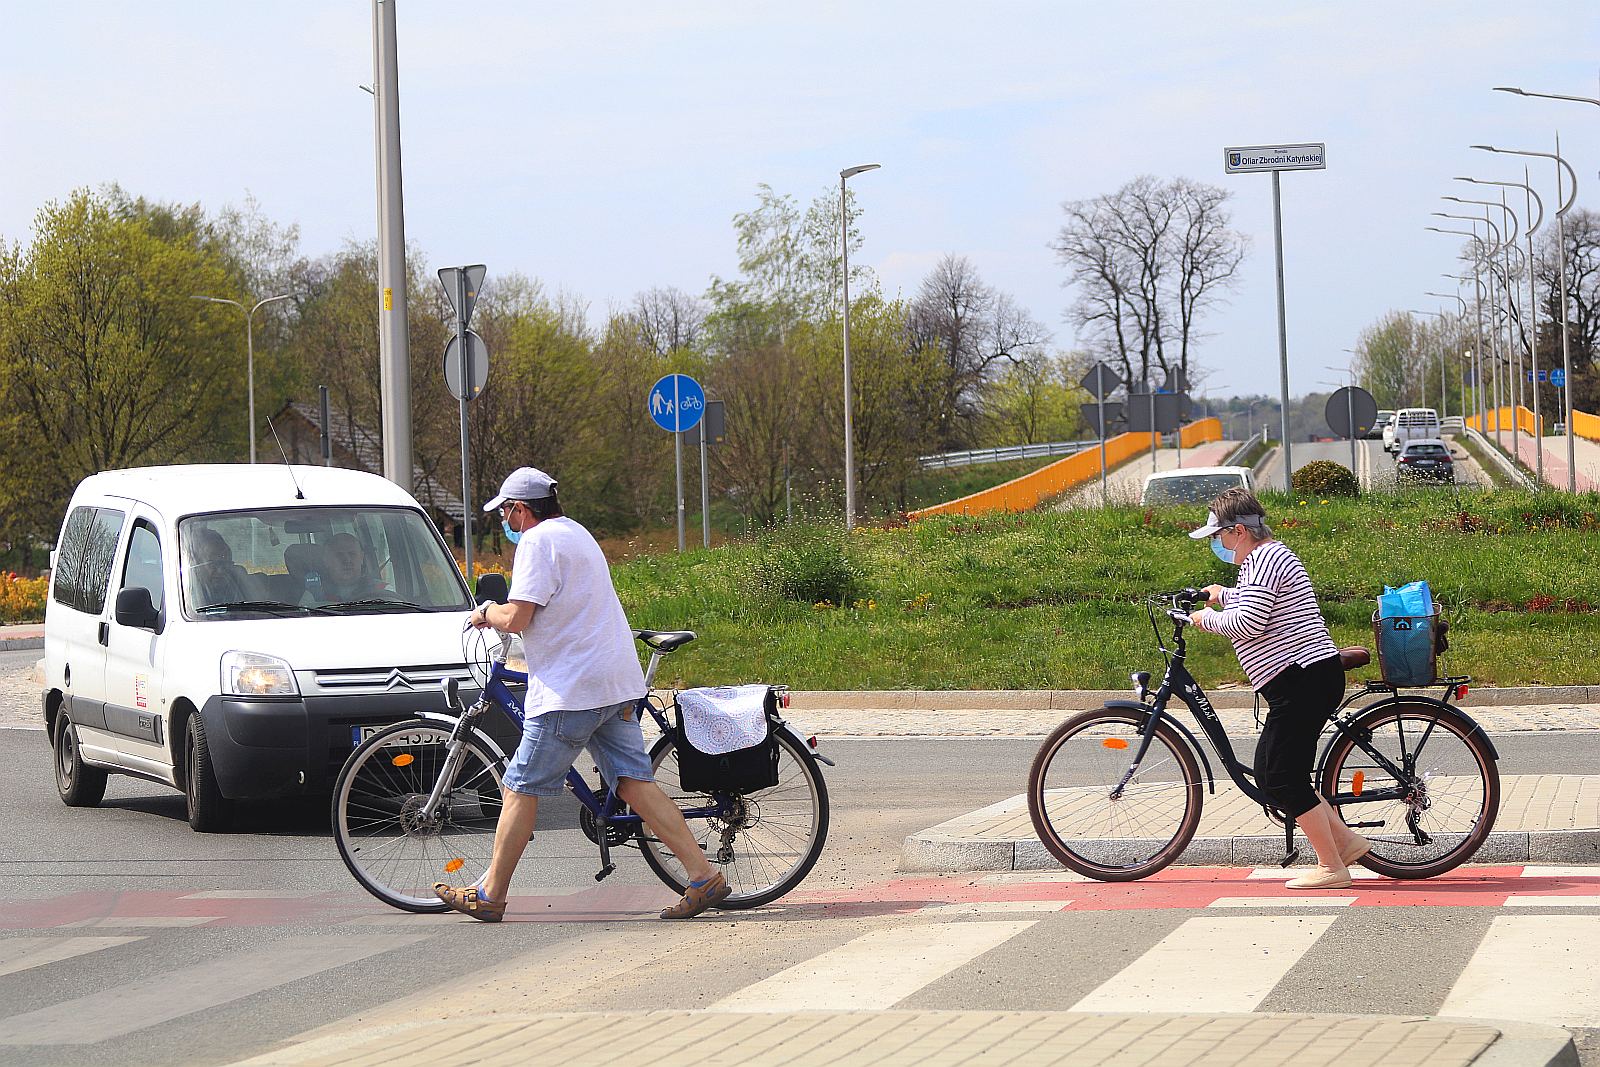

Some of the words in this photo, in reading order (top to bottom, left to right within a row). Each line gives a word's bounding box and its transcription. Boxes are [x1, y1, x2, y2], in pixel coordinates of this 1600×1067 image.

[1241, 157, 1259, 165] Ofiar
[1259, 155, 1286, 164] Zbrodni
[1286, 153, 1322, 164] Katyńskiej
